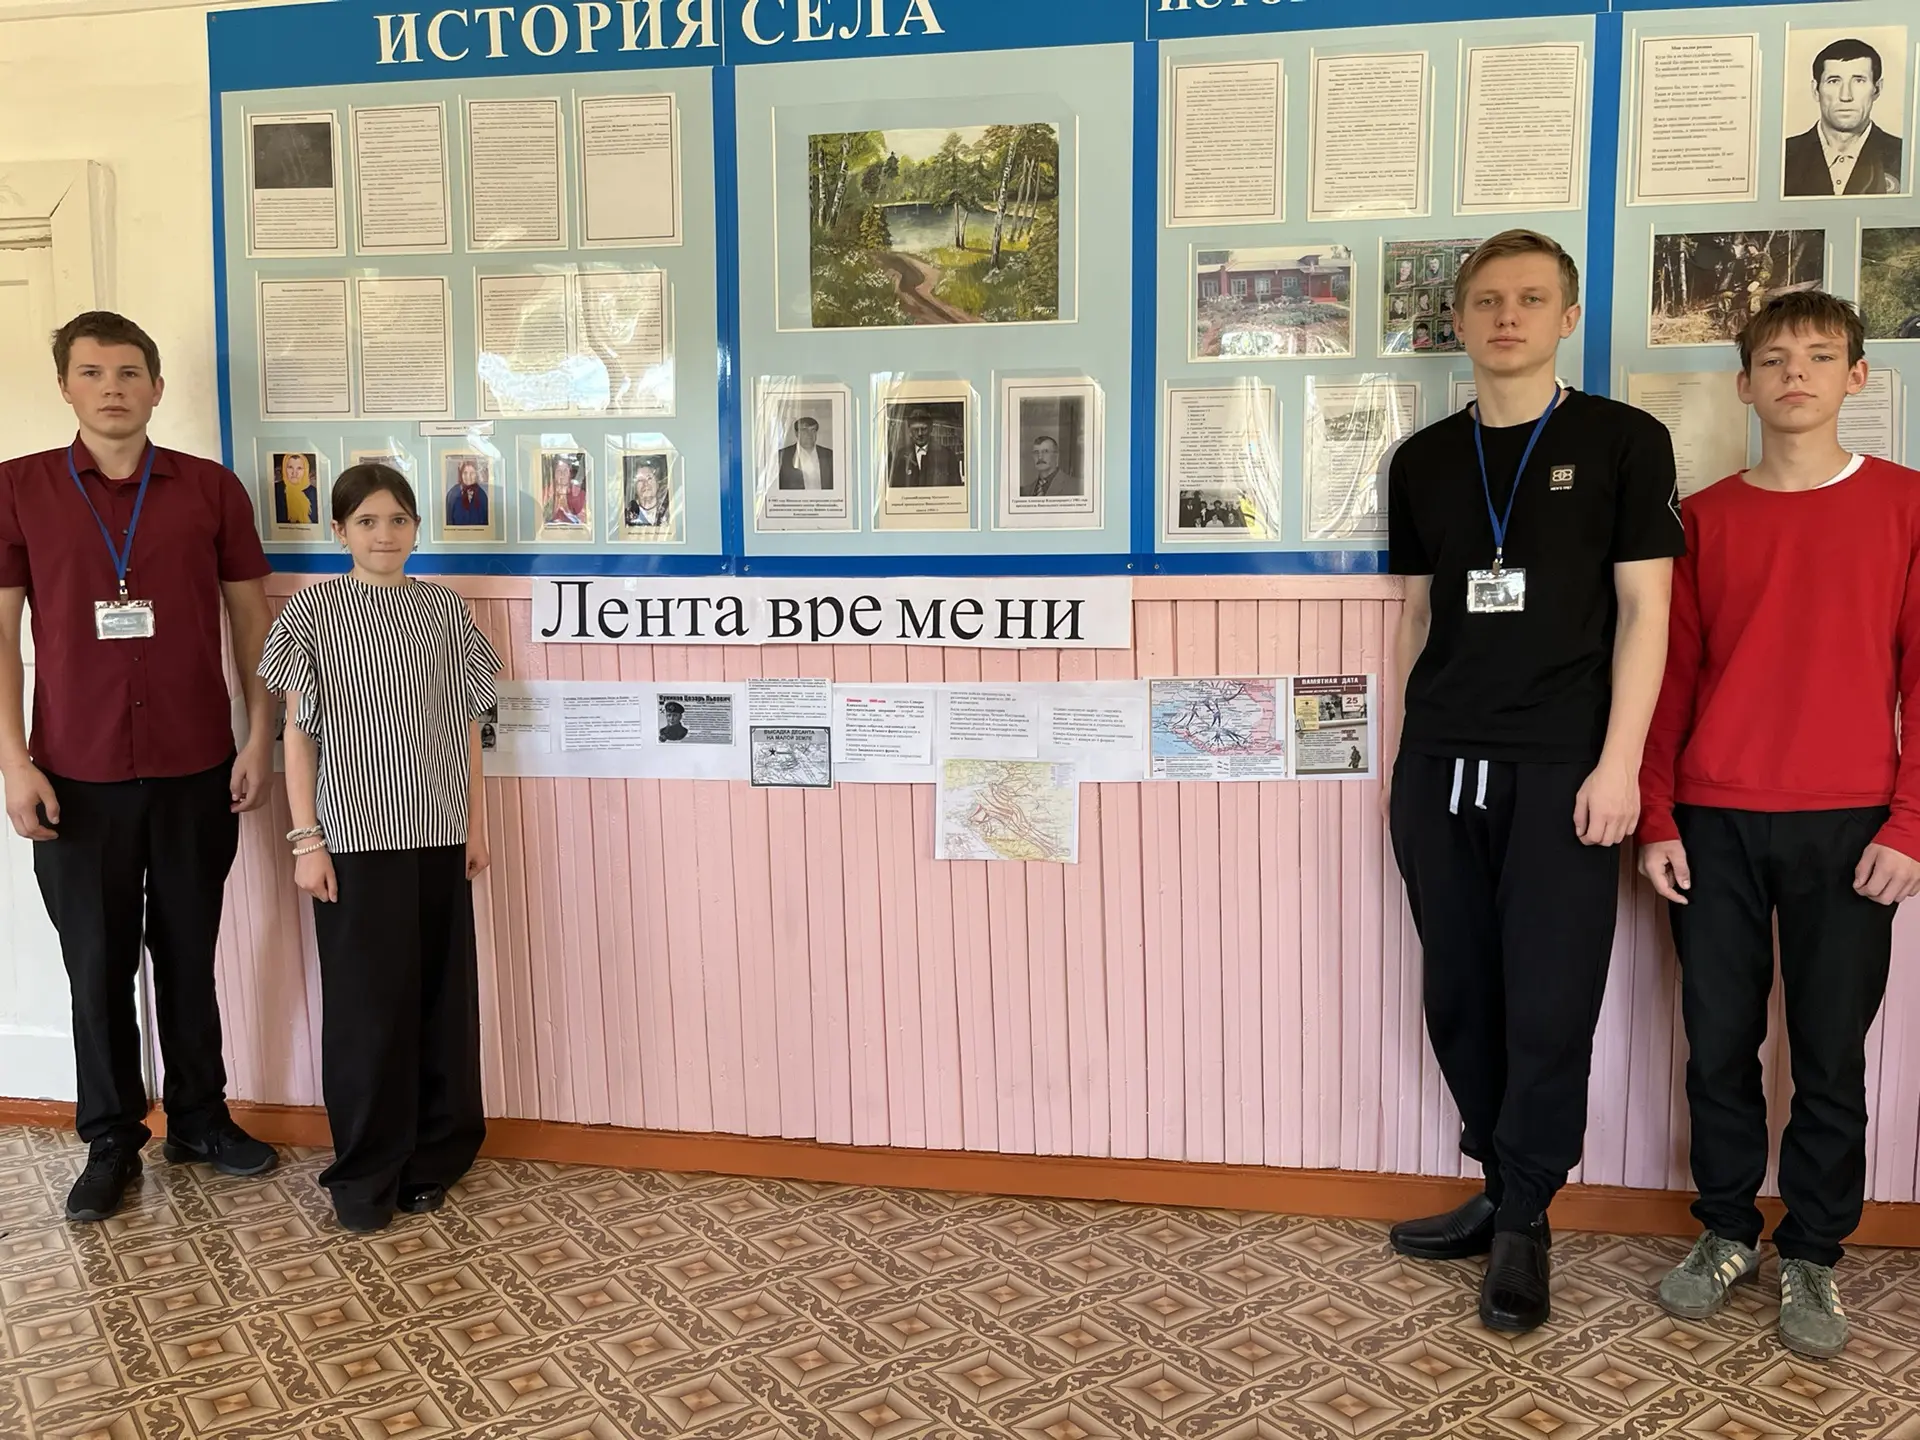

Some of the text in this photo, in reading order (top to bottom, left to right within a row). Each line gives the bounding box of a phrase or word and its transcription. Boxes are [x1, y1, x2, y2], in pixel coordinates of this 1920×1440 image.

[373, 0, 946, 65] ИСТОРИЯ СЕЛА
[541, 580, 749, 638] Лента
